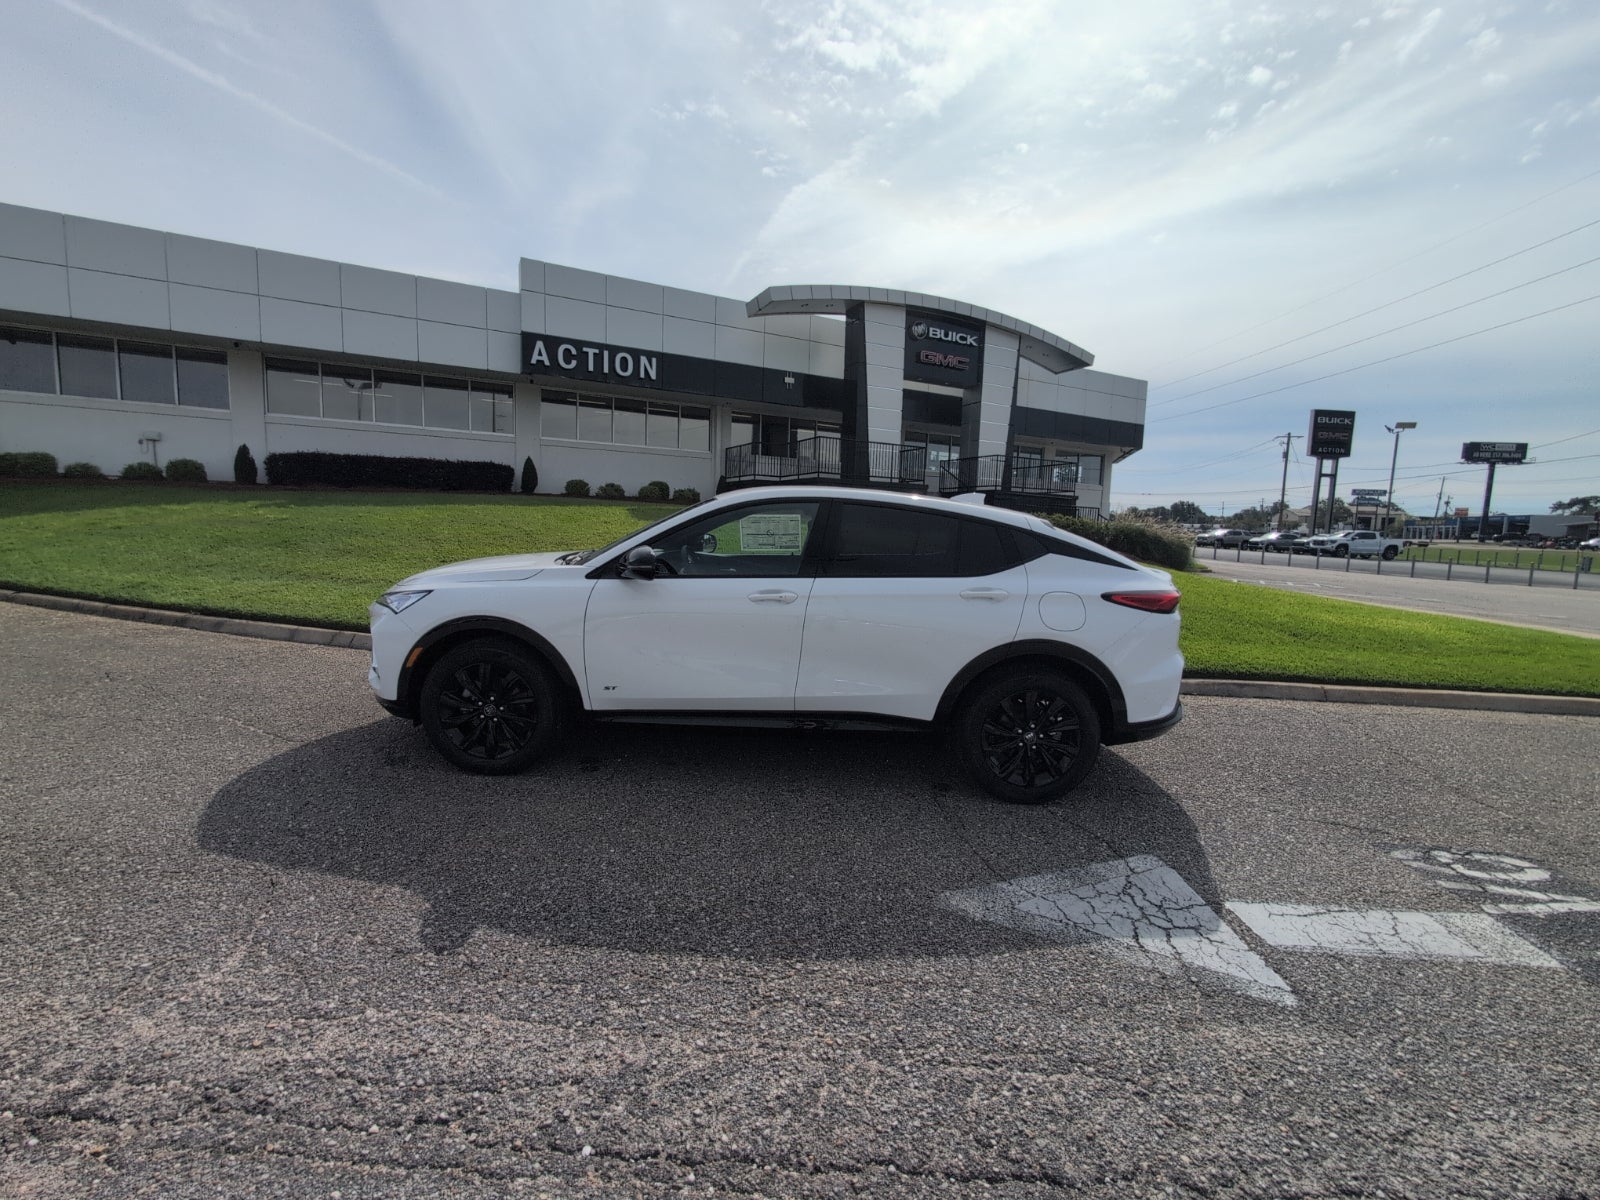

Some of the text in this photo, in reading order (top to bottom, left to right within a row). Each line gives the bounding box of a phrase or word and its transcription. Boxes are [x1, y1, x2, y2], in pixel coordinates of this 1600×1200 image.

[928, 326, 979, 347] BUICK
[530, 340, 657, 380] ACTION
[920, 350, 970, 370] GMC
[1317, 416, 1353, 425] BUICK
